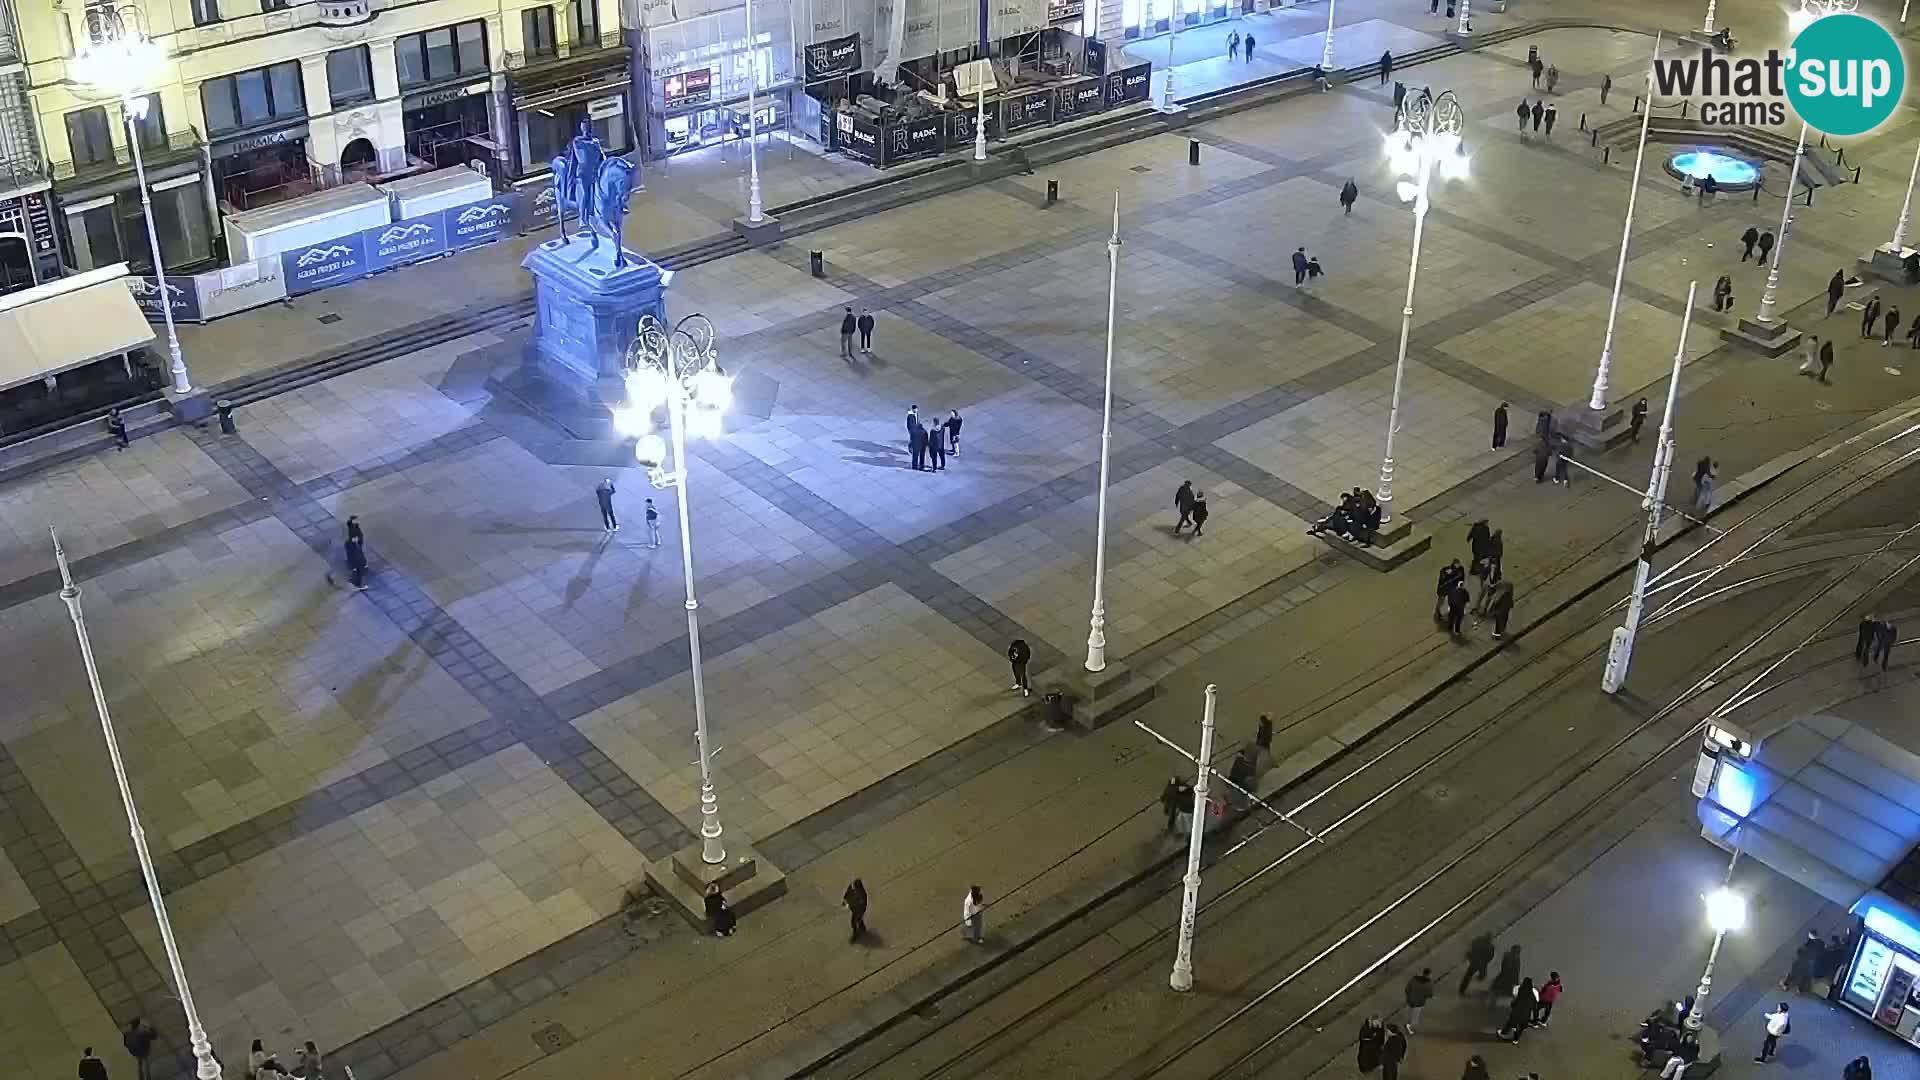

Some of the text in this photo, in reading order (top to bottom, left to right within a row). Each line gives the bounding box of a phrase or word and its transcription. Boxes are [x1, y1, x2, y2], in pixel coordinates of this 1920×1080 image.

[832, 43, 855, 57] RADIĆ
[1126, 72, 1147, 86] RADIĆ
[1078, 86, 1099, 100] RADIĆ
[1025, 99, 1047, 111] RADIĆ
[971, 110, 993, 124] RIĆ
[854, 129, 876, 144] RADIĆ
[912, 126, 937, 139] RADIĆ
[233, 132, 287, 152] HARMICA
